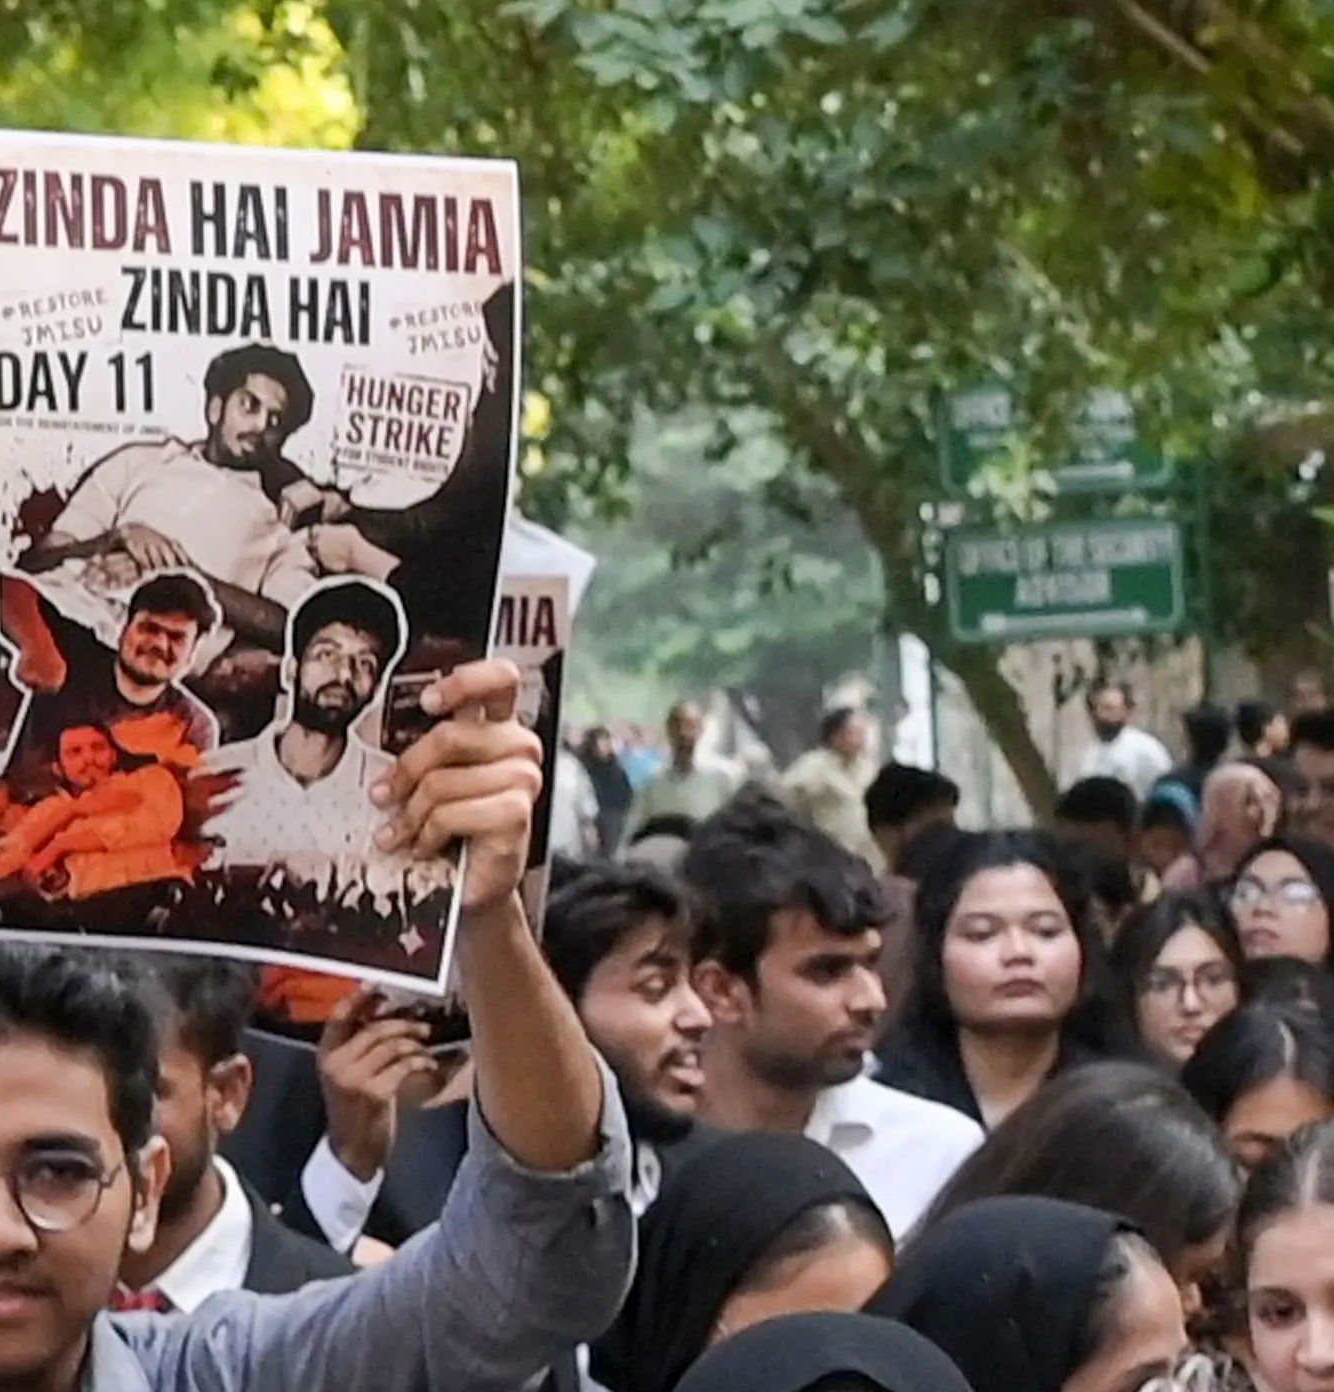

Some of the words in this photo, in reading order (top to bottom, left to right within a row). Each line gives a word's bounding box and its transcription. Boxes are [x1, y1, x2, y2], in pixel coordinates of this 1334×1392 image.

[189, 180, 289, 261] HAI
[309, 187, 502, 276] JAMIA
[120, 265, 272, 339] ZINDA
[289, 275, 370, 346] HAI
[107, 350, 154, 413] 11
[347, 373, 462, 422] HUNGER
[345, 410, 455, 460] STRIKE
